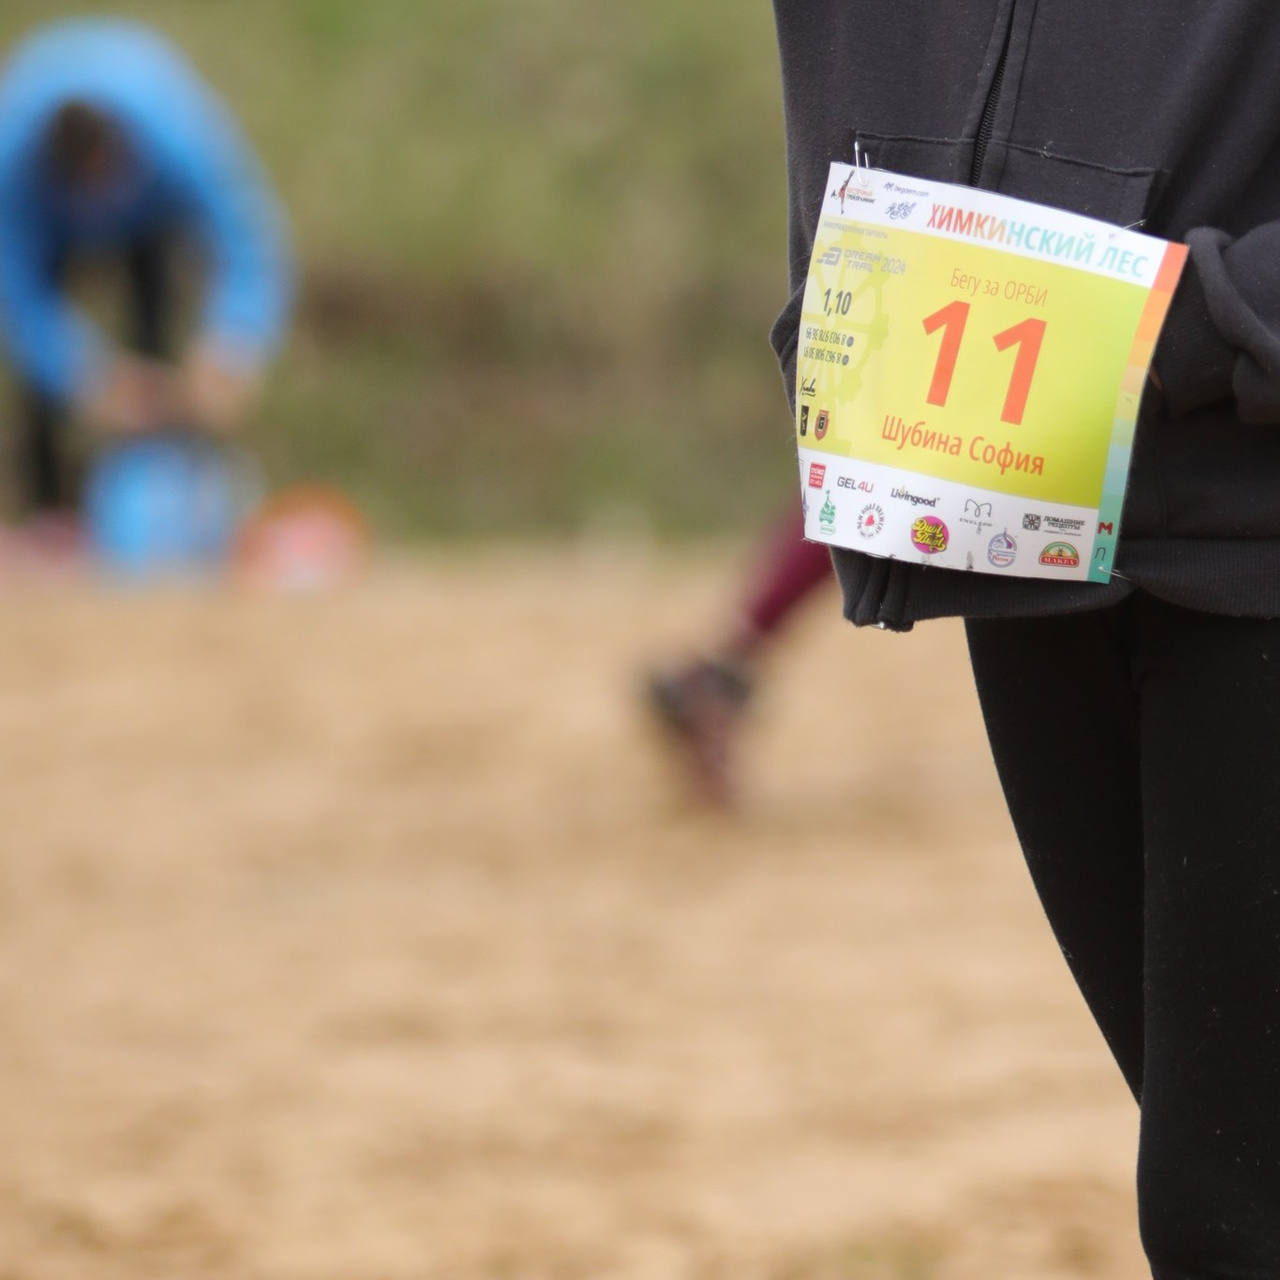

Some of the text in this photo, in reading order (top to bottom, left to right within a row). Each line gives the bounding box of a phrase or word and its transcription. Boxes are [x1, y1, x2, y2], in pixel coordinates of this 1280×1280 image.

[926, 202, 1149, 278] ХИМКИНСКИЙ ЛЕС
[843, 249, 882, 262] DREAM
[846, 260, 874, 273] TRAIL
[880, 256, 907, 276] 2024
[950, 267, 1049, 308] Бегу за ОРБИ
[823, 288, 852, 317] 1,10
[922, 300, 1048, 426] 11
[881, 414, 1046, 478] Шубина София
[890, 485, 937, 509] Livingood
